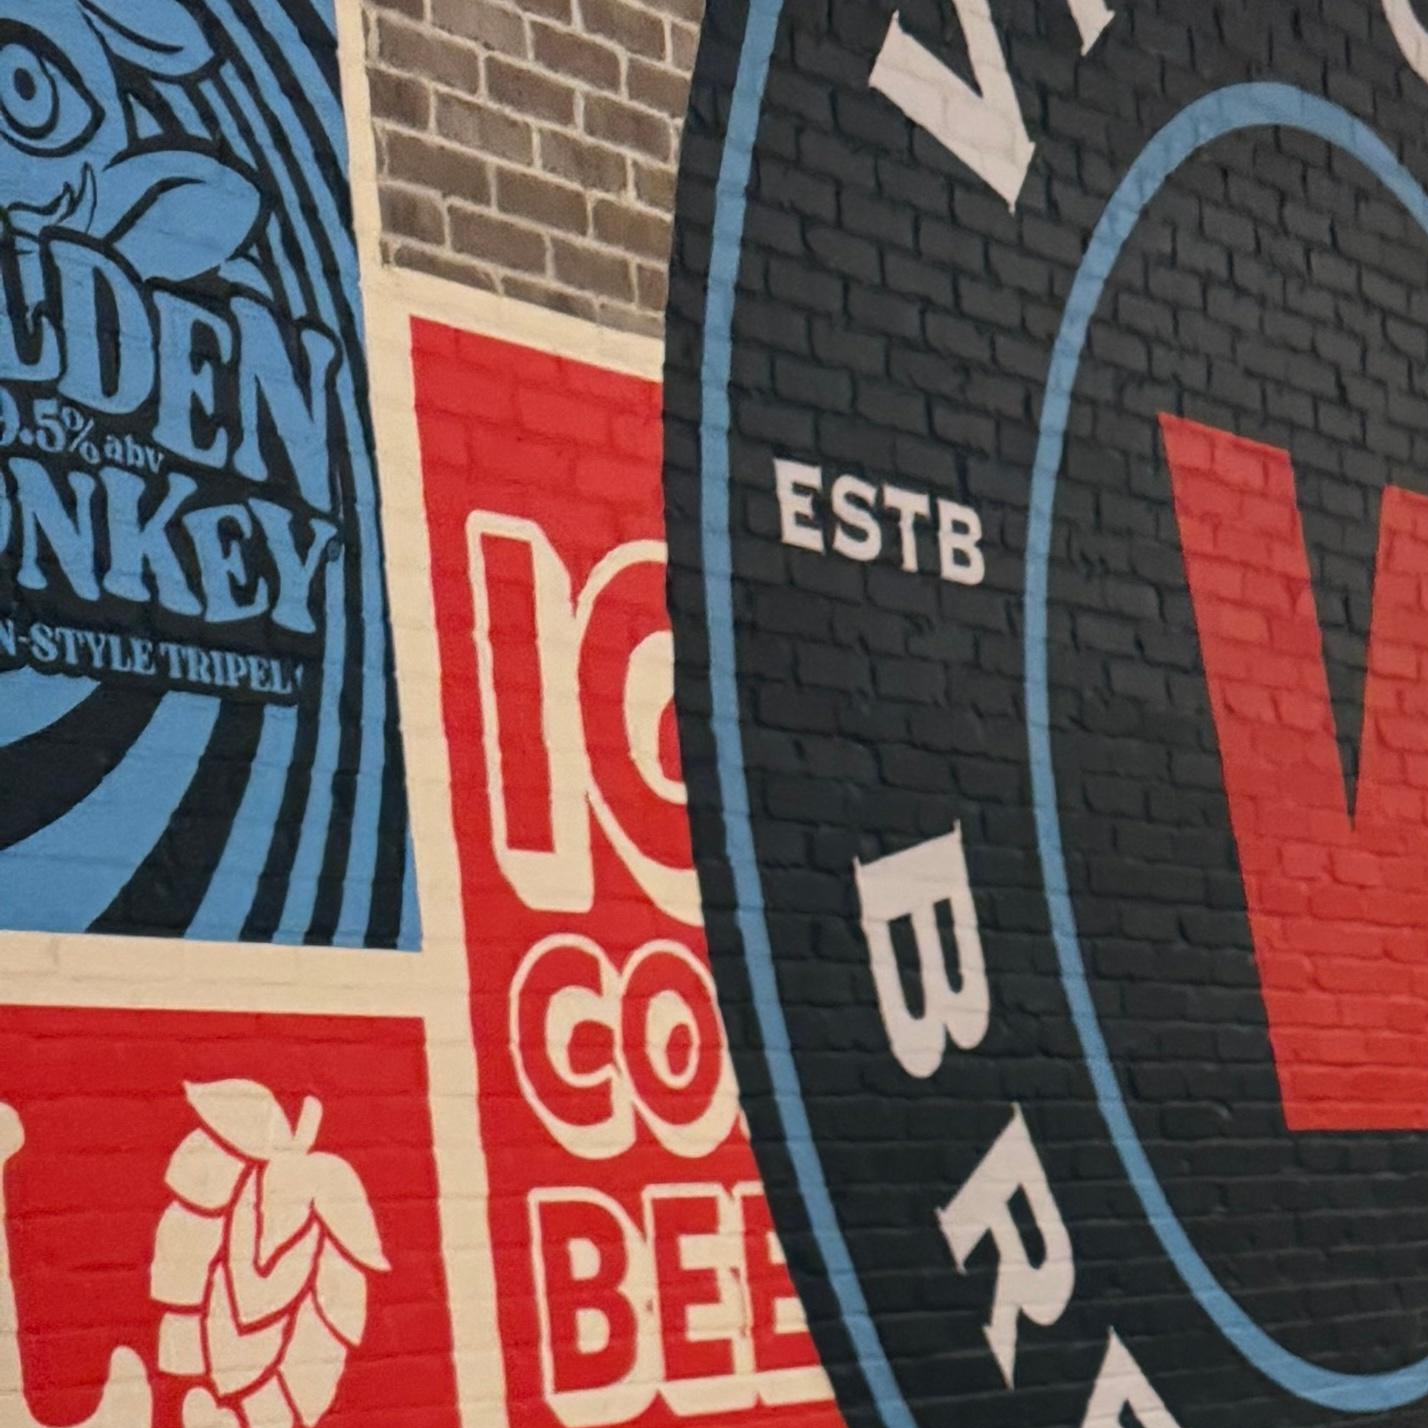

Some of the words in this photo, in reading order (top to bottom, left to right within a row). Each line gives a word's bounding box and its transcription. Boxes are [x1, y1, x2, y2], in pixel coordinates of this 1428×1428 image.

[103, 433, 164, 474] abv
[0, 456, 338, 634] NKEY
[773, 456, 986, 586] ESTB
[159, 641, 292, 695] TRIPEL
[509, 932, 748, 1160] CO
